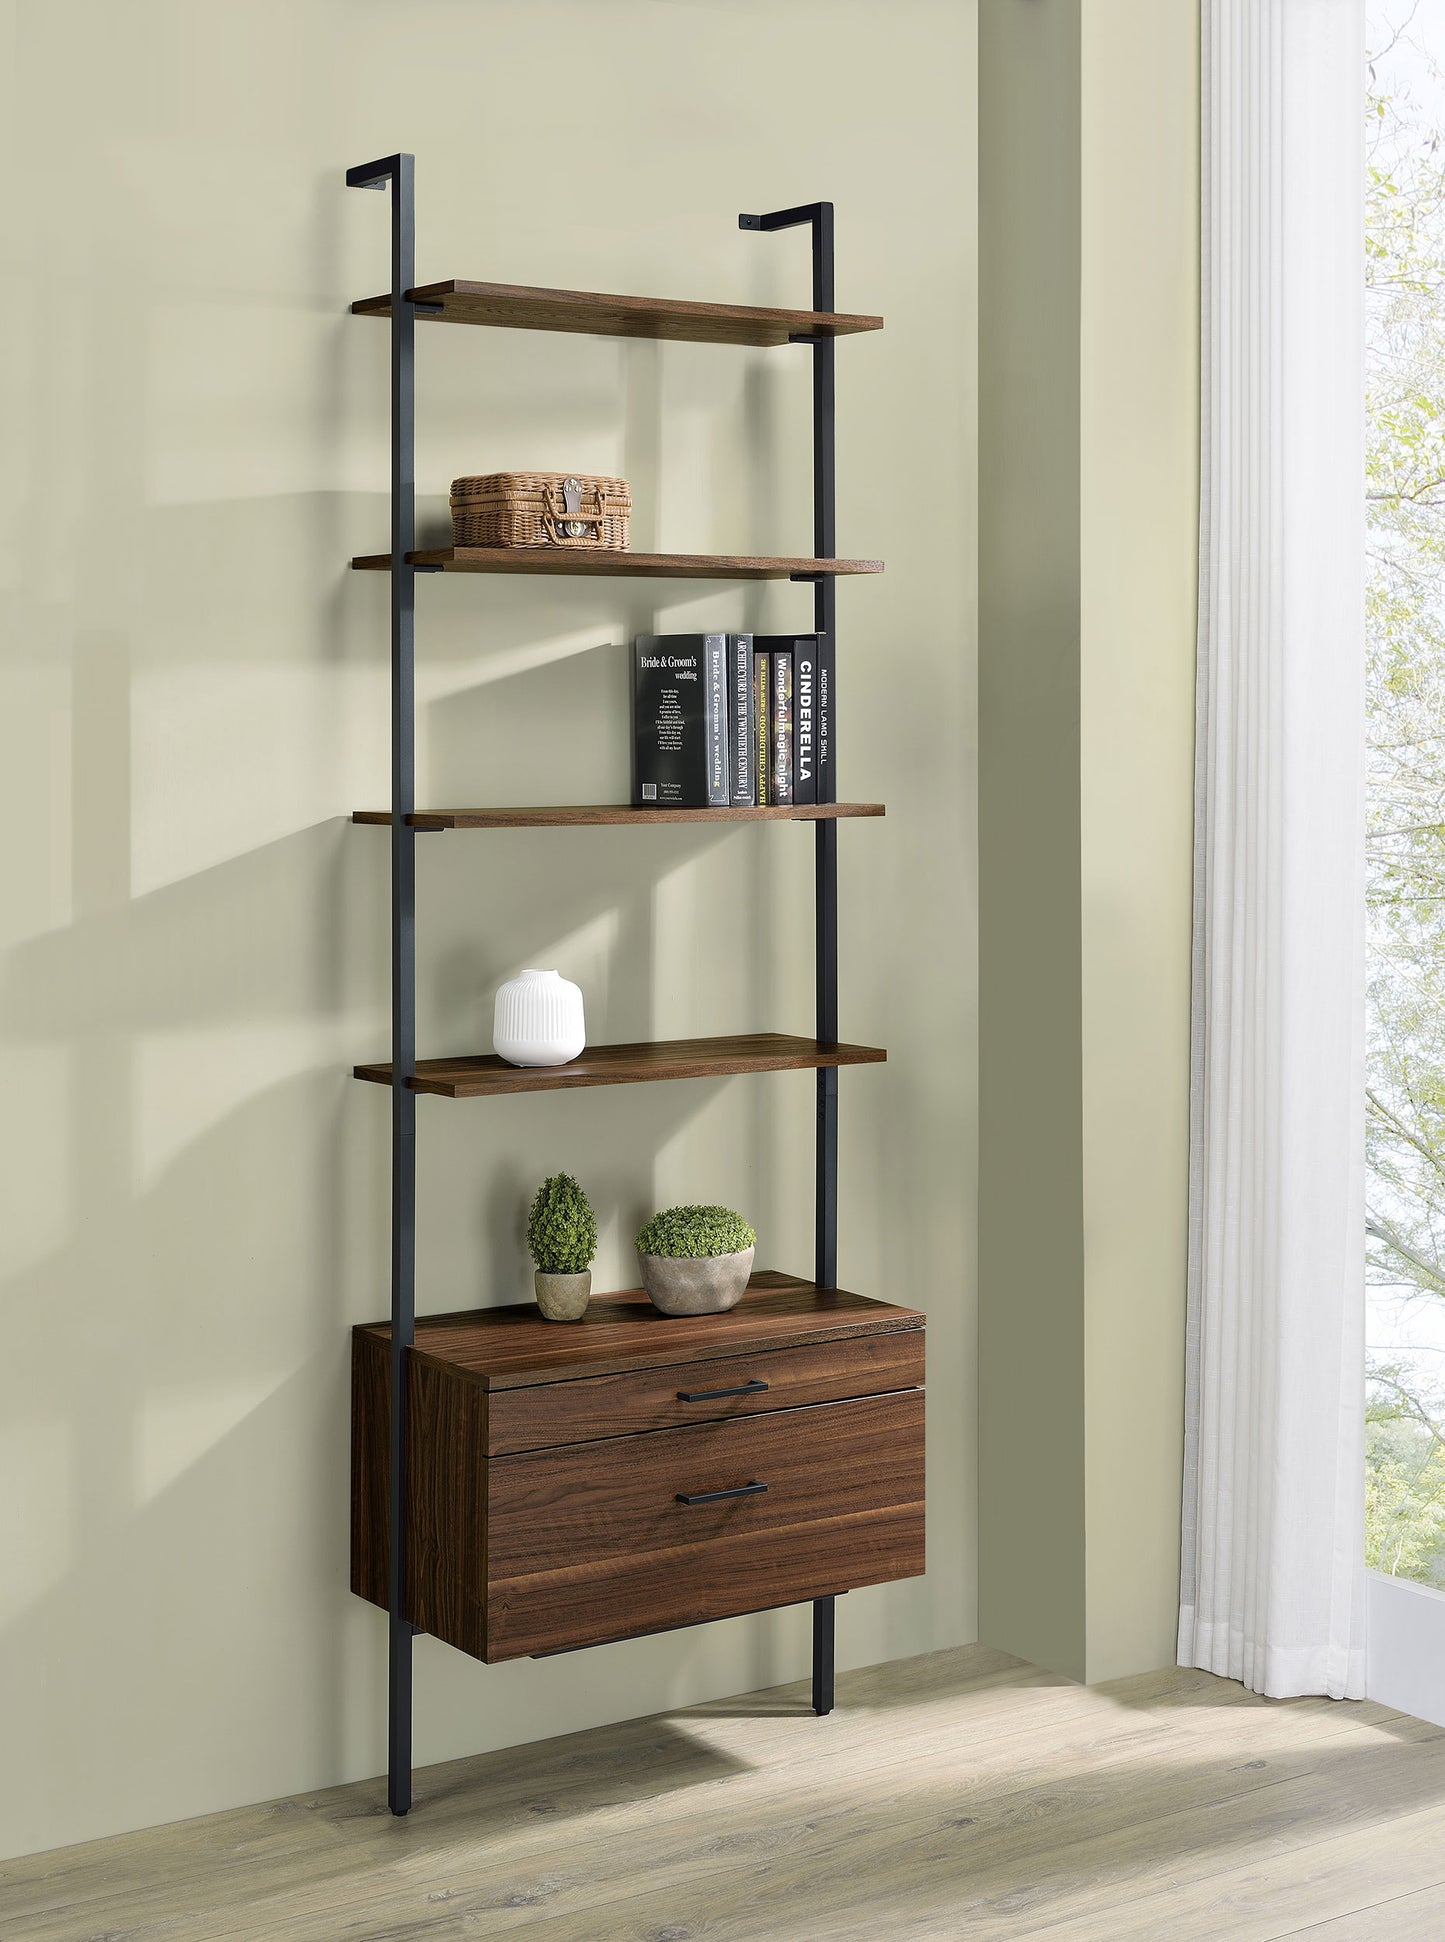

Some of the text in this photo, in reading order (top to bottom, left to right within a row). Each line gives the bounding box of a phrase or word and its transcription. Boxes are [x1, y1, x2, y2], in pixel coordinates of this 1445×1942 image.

[641, 655, 697, 668] Bride & Groom's
[712, 651, 720, 680] Bride
[760, 659, 766, 670] ME
[675, 671, 698, 682] wedding
[713, 682, 720, 692] &
[738, 693, 747, 701] IN
[738, 702, 747, 716] THE
[800, 660, 811, 781] CINDERELLA
[738, 717, 748, 756] TWENTIETH
[713, 744, 721, 788] wedding
[738, 757, 748, 789] CENTURY
[777, 764, 788, 797] night
